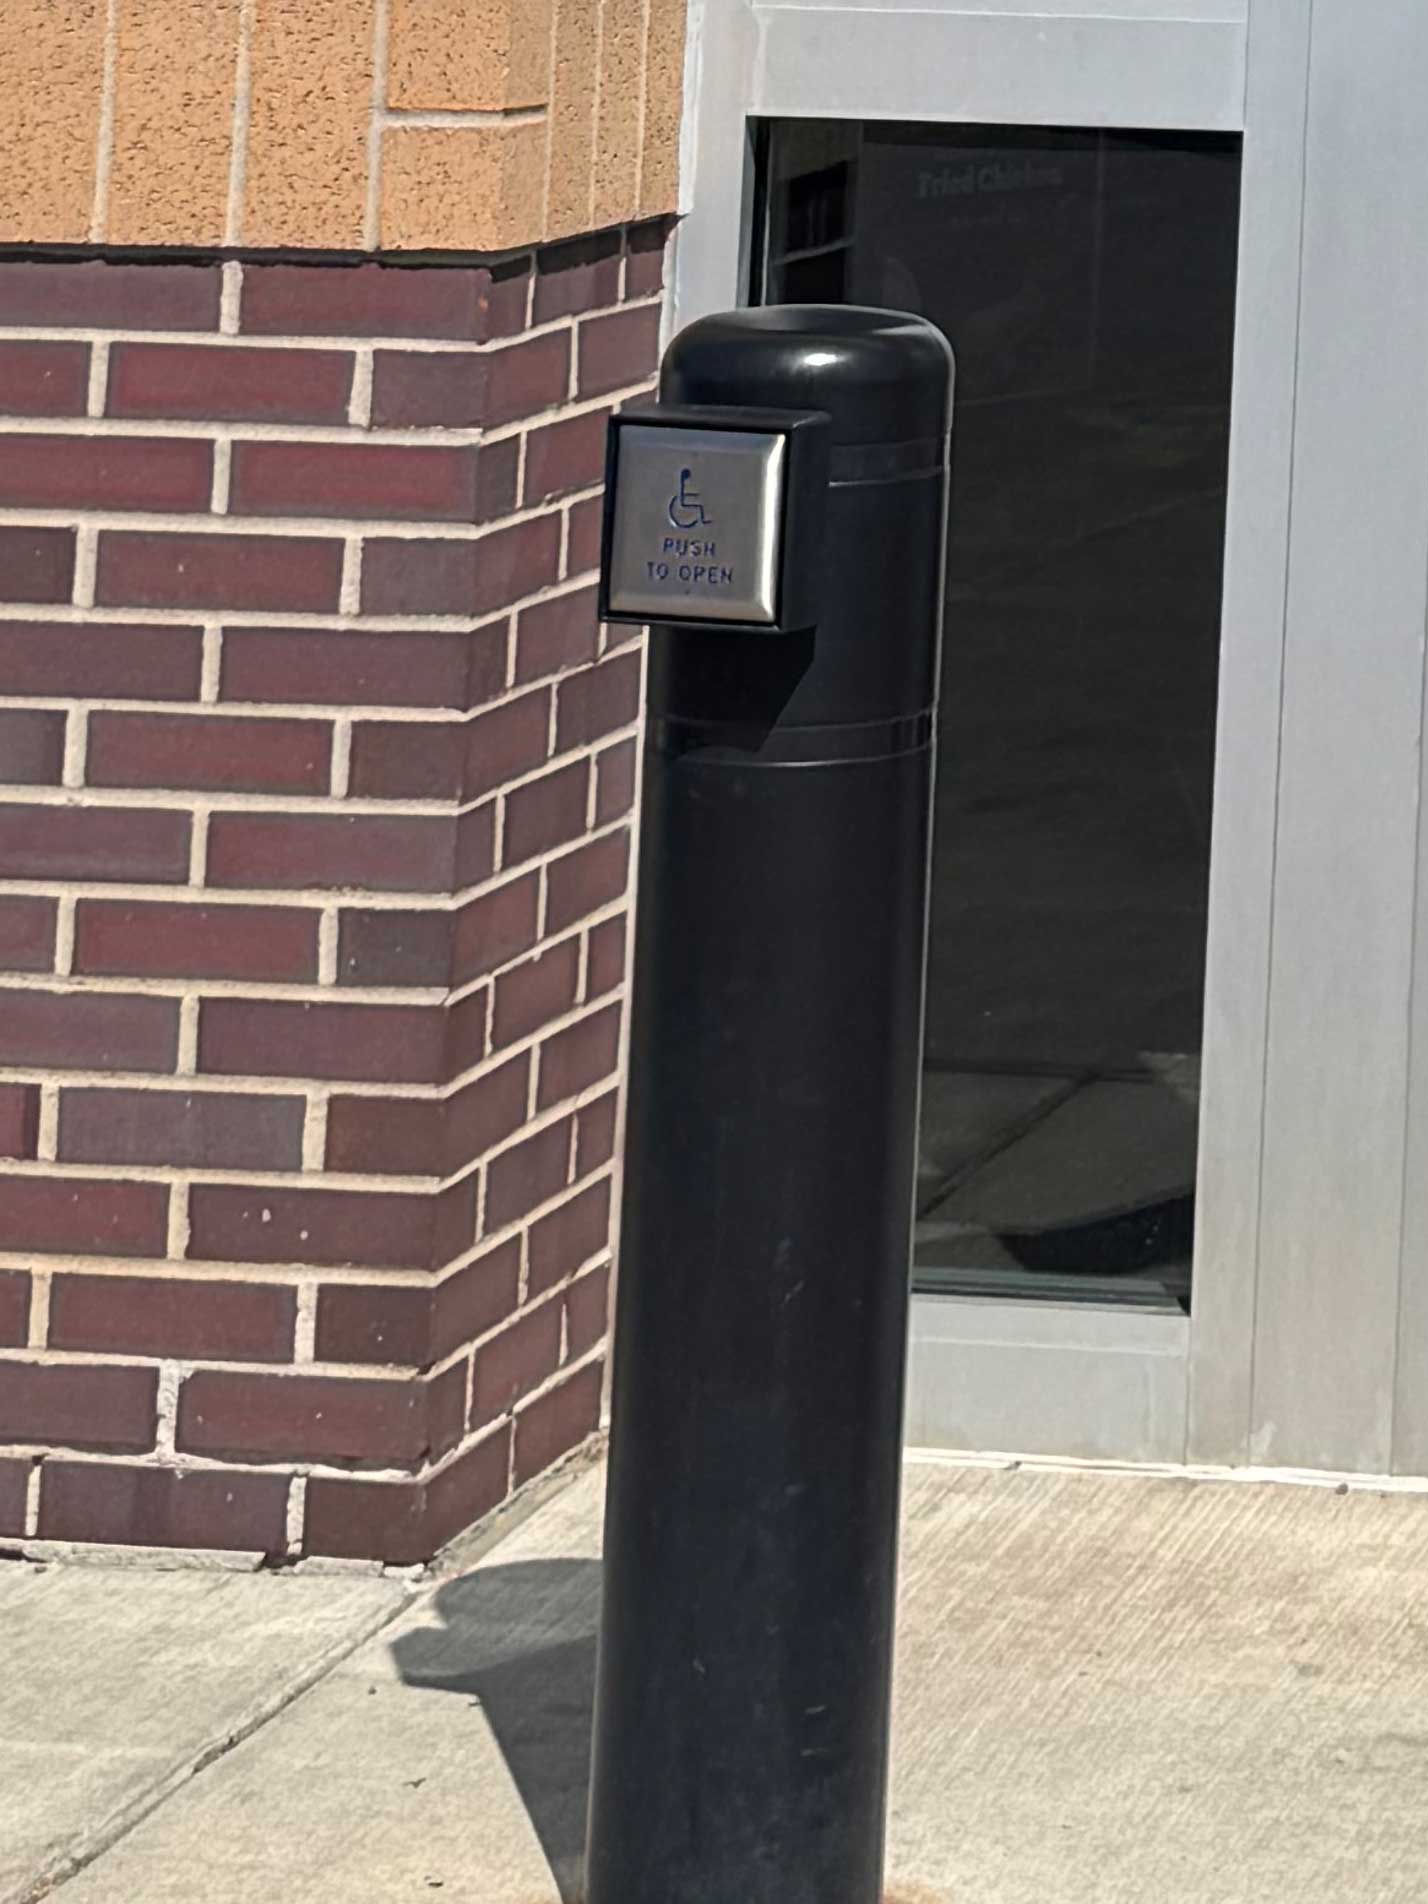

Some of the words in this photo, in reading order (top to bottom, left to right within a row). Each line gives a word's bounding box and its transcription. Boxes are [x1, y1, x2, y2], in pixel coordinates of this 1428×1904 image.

[663, 538, 717, 557] PUSH
[647, 561, 669, 581] TO
[679, 564, 734, 585] OPEN
